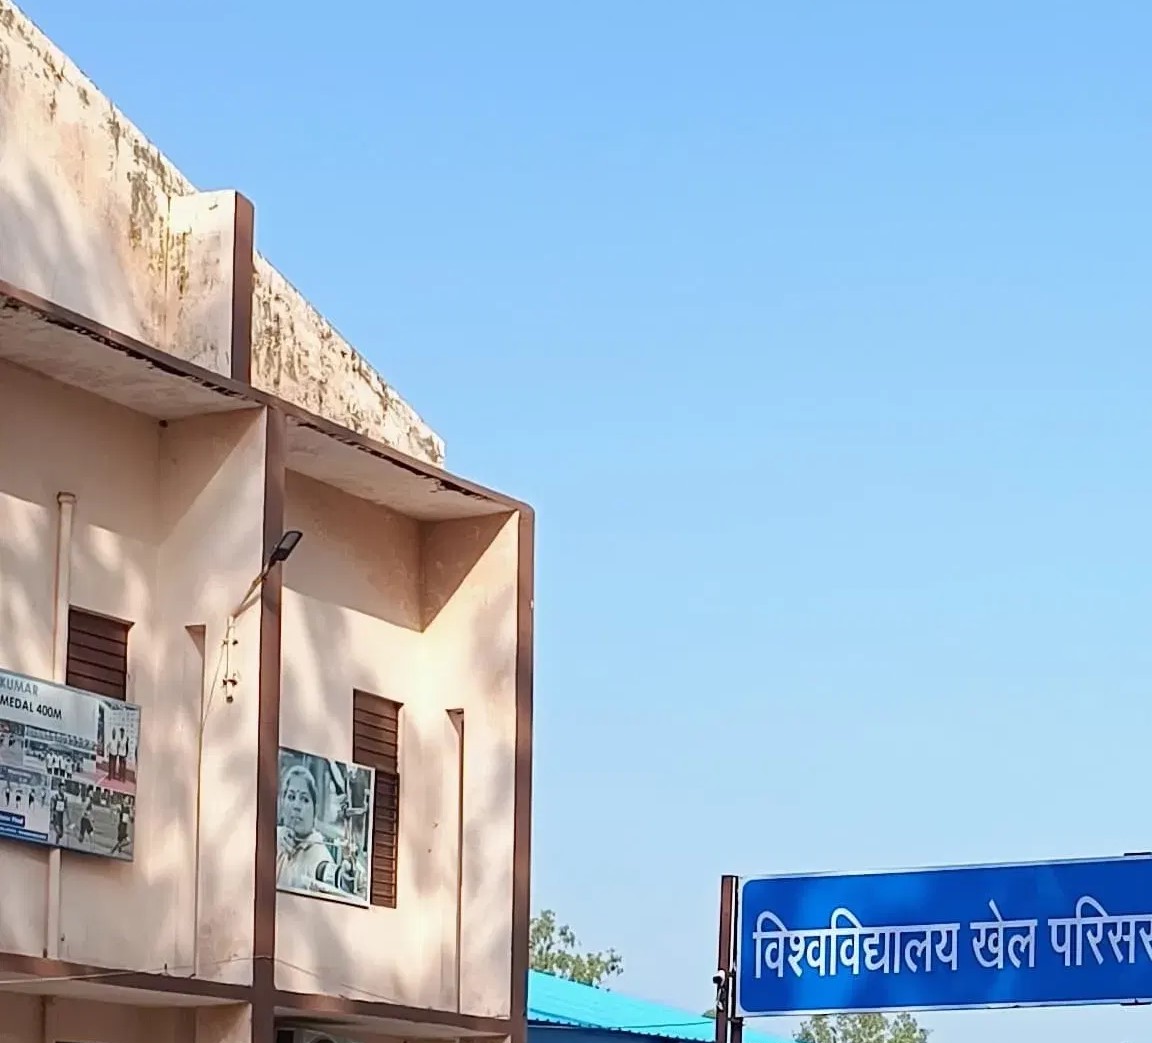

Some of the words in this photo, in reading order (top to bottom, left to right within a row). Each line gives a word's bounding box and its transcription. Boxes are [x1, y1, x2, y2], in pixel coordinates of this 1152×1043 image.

[0, 694, 34, 713] MEDAL
[36, 704, 63, 720] 400M
[752, 907, 961, 979] विश्वविद्यालय
[970, 900, 1038, 970] खेल
